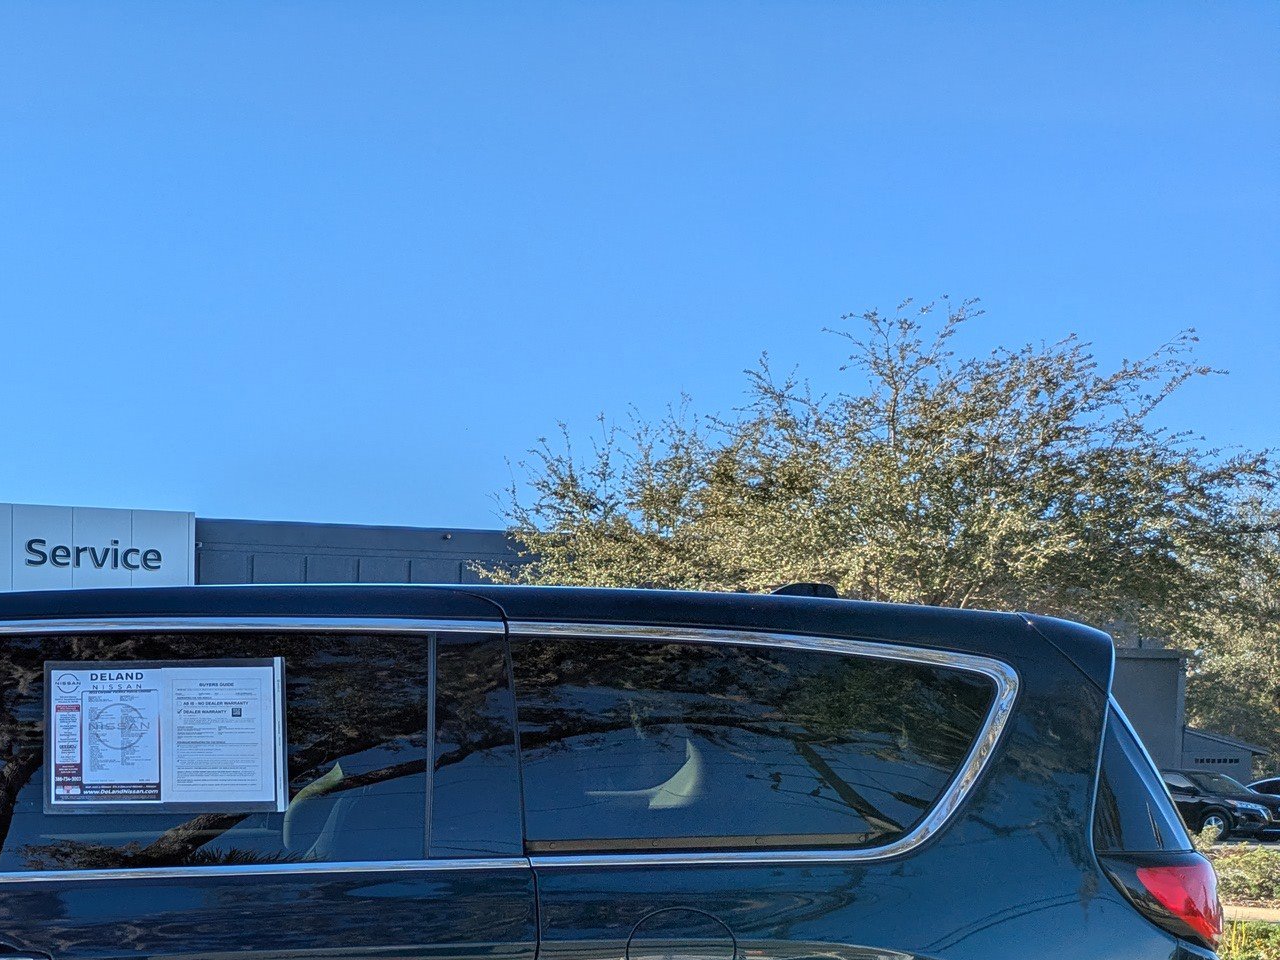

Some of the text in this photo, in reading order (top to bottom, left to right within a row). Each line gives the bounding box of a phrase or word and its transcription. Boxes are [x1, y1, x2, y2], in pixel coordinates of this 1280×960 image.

[25, 538, 163, 571] Service
[90, 672, 144, 681] DELAND
[89, 722, 150, 731] NISSAN
